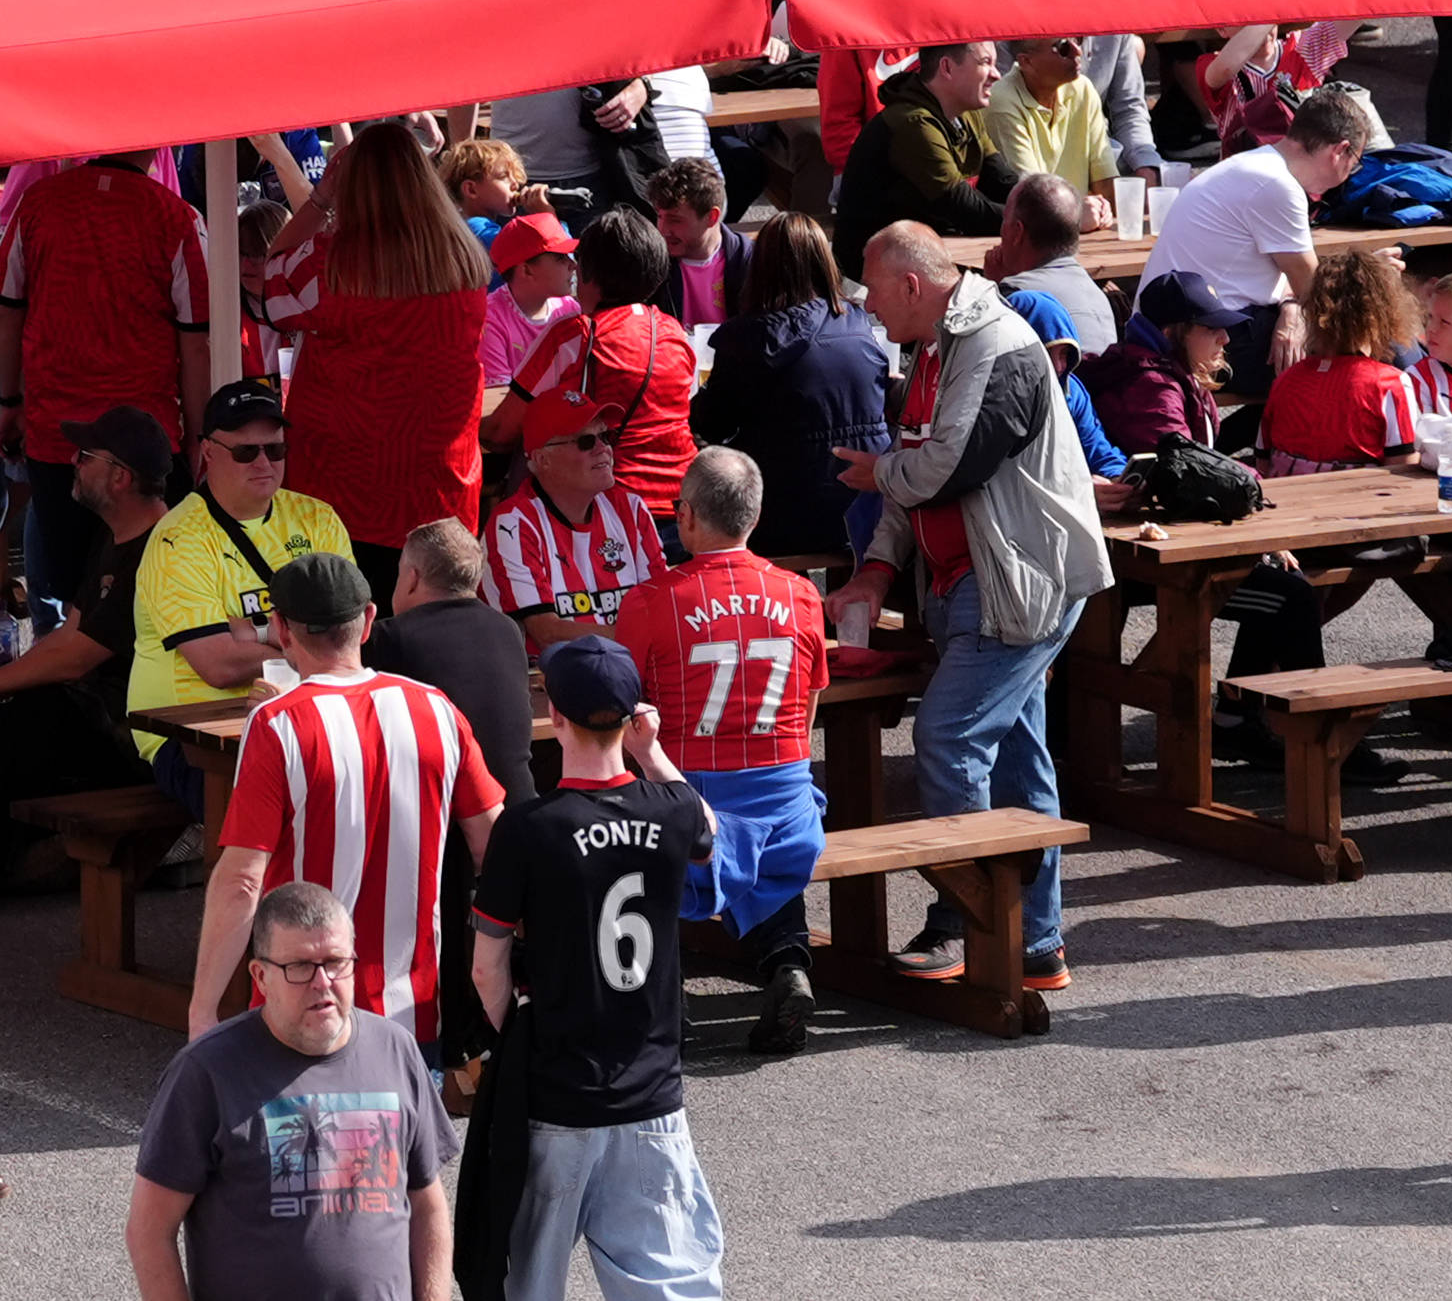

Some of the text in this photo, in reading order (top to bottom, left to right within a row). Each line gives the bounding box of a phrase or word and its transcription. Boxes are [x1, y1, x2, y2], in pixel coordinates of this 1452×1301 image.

[684, 593, 791, 632] MARTIN
[687, 637, 794, 737] 77
[572, 819, 663, 857] FONTE
[597, 871, 654, 992] 6
[270, 1191, 397, 1218] animal
